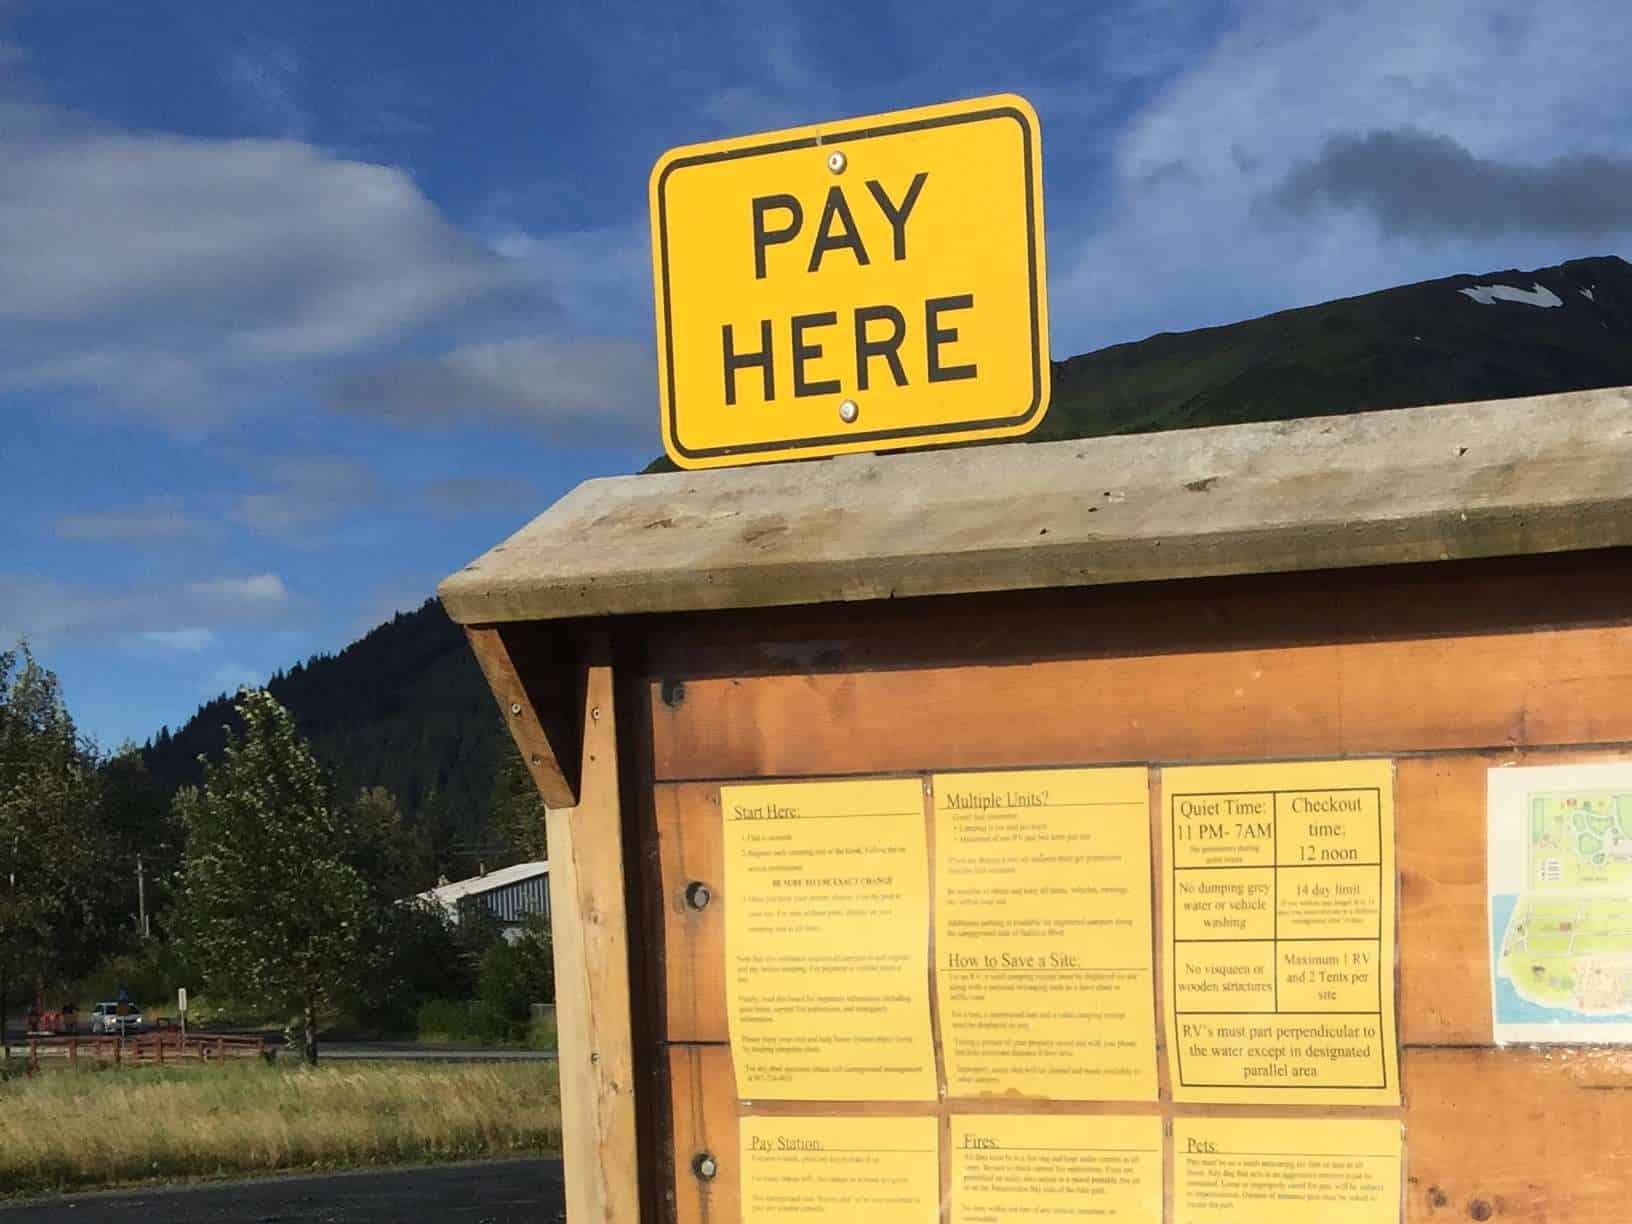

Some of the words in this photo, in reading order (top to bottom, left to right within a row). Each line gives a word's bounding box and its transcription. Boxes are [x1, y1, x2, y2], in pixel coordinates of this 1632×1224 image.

[752, 172, 928, 280] PAY
[722, 293, 977, 406] HERE
[946, 793, 1003, 811] Multiple
[1007, 790, 1049, 808] Units?
[1180, 800, 1220, 818] Quiet
[1223, 799, 1266, 815] Time:
[1291, 797, 1363, 814] Checkout
[734, 806, 764, 820] Start
[767, 804, 801, 819] Here:
[1178, 825, 1193, 841] 11
[1235, 823, 1273, 839] 7AM
[1308, 821, 1347, 837] time:
[1298, 846, 1316, 861] 12
[1321, 847, 1358, 861] noon
[1178, 882, 1195, 894] No
[1198, 881, 1244, 896] dumping
[1247, 884, 1272, 897] grey
[1296, 884, 1310, 896] 14
[1312, 884, 1331, 898] day
[1335, 881, 1361, 895] limit
[1183, 900, 1212, 911] water
[1215, 901, 1226, 911] or
[1230, 898, 1268, 911] vehicle
[1203, 916, 1247, 930] washing
[949, 952, 978, 968] How
[984, 954, 998, 968] to
[1001, 952, 1035, 968] Save
[1037, 957, 1047, 968] a
[1050, 952, 1081, 968] Site:
[1284, 954, 1340, 966] Maximum
[1352, 953, 1371, 965] RV
[1184, 962, 1202, 975] No
[1205, 964, 1250, 977] visqueen
[1252, 964, 1265, 974] or
[1286, 971, 1306, 983] and
[1308, 971, 1317, 983] 2
[1318, 970, 1350, 983] Tents
[1351, 973, 1370, 985] per
[1178, 982, 1220, 993] wooden
[1221, 981, 1273, 993] structures
[1317, 988, 1338, 1001] site
[1182, 1024, 1214, 1038] RV's
[1217, 1026, 1247, 1038] must
[1276, 1023, 1361, 1041] perpendicular
[1363, 1026, 1377, 1038] to
[1189, 1043, 1209, 1057] the
[1211, 1046, 1243, 1058] water
[1247, 1045, 1288, 1061] except
[1290, 1044, 1303, 1057] in
[1304, 1045, 1371, 1061] designated
[1243, 1063, 1288, 1079] parallel
[1291, 1065, 1318, 1078] area
[752, 1135, 773, 1153] Pay
[777, 1135, 825, 1151] Station:
